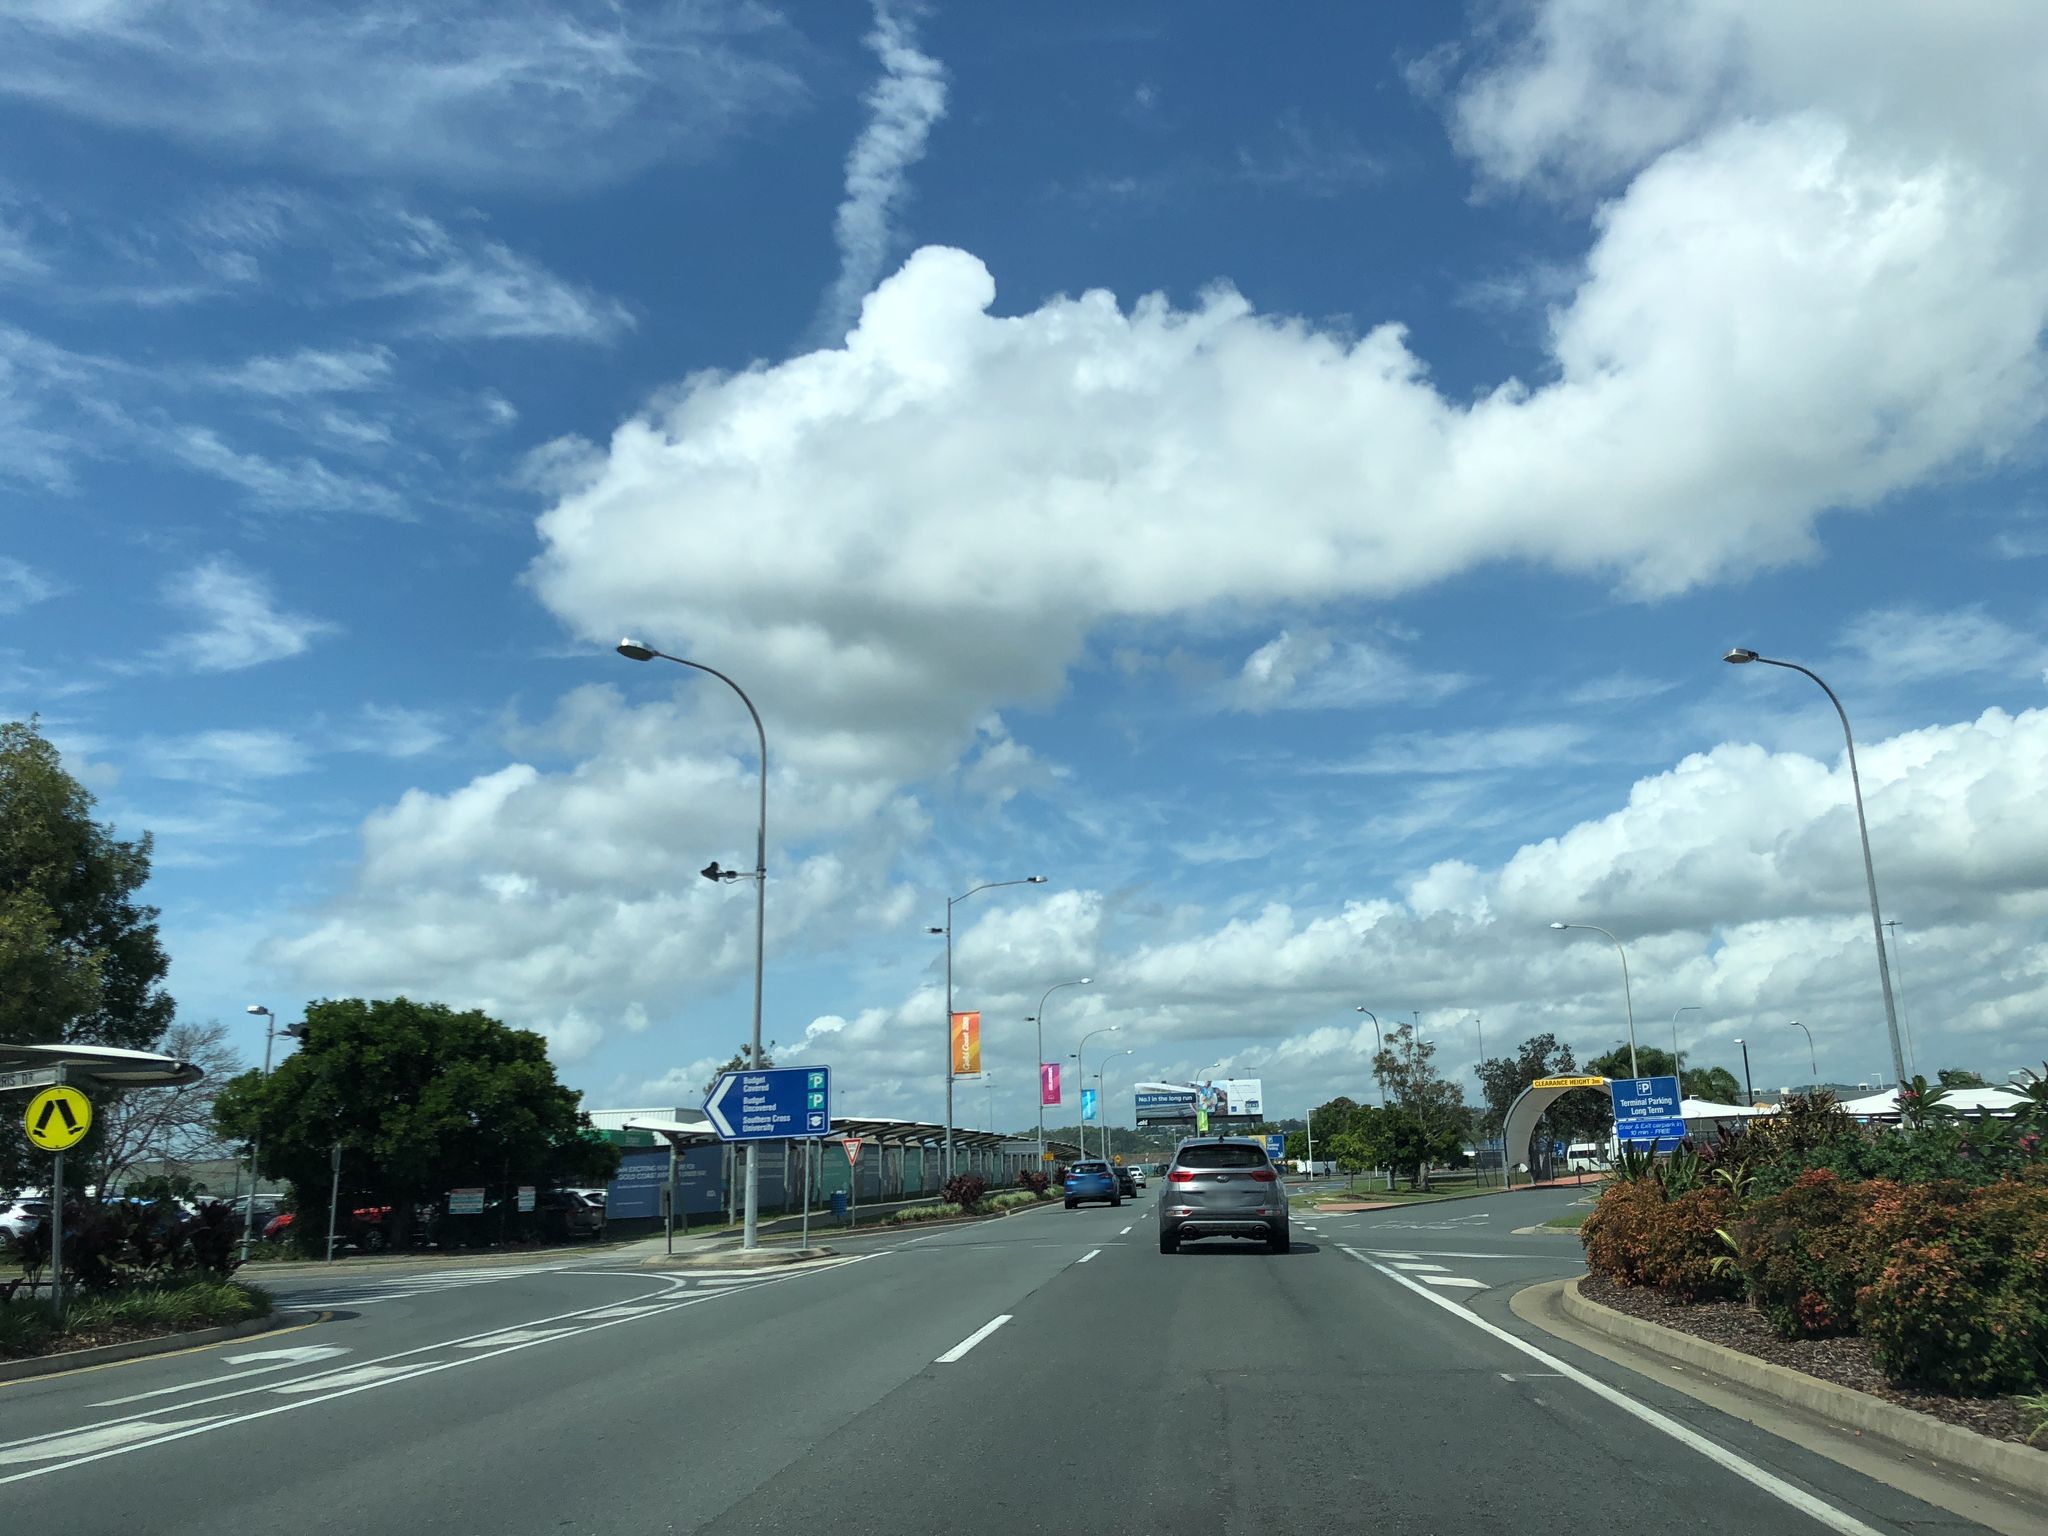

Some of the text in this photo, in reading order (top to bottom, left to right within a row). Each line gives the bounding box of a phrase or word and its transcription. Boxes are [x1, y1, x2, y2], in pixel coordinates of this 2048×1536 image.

[743, 1076, 766, 1085] Budget
[743, 1083, 770, 1092] Covered
[743, 1096, 766, 1105] Budget
[1620, 1097, 1673, 1107] Terminal Parking
[743, 1103, 777, 1112] Uncovered
[1631, 1106, 1664, 1116] Long Term
[743, 1116, 771, 1124] Southern
[743, 1124, 775, 1132] University
